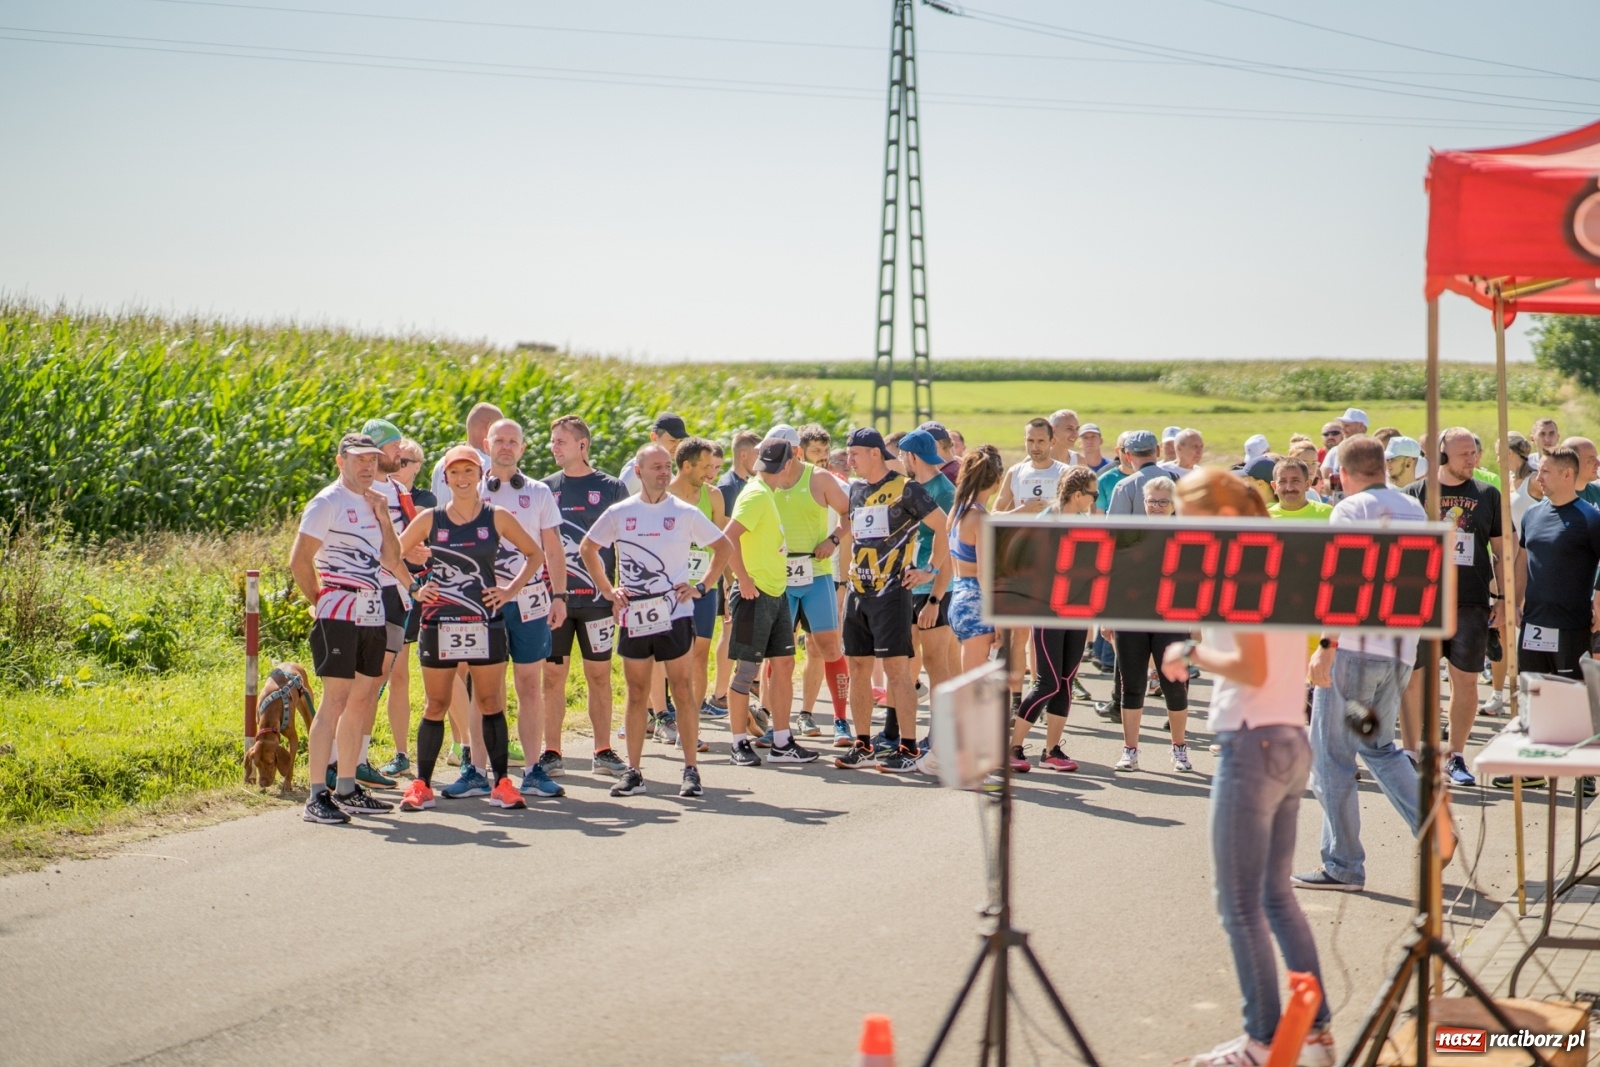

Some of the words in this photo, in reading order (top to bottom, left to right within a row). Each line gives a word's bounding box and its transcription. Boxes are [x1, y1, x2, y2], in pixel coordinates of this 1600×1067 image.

[1032, 485, 1043, 497] 6
[1440, 497, 1479, 511] MISTRY
[865, 514, 874, 528] 9
[1454, 541, 1465, 554] 4
[1050, 528, 1116, 618] 0
[1155, 530, 1284, 623] 00
[1314, 534, 1443, 627] 00
[528, 590, 548, 609] 21
[366, 599, 381, 615] 37
[634, 607, 659, 625] 16
[1532, 626, 1543, 640] 2
[450, 633, 477, 648] 35
